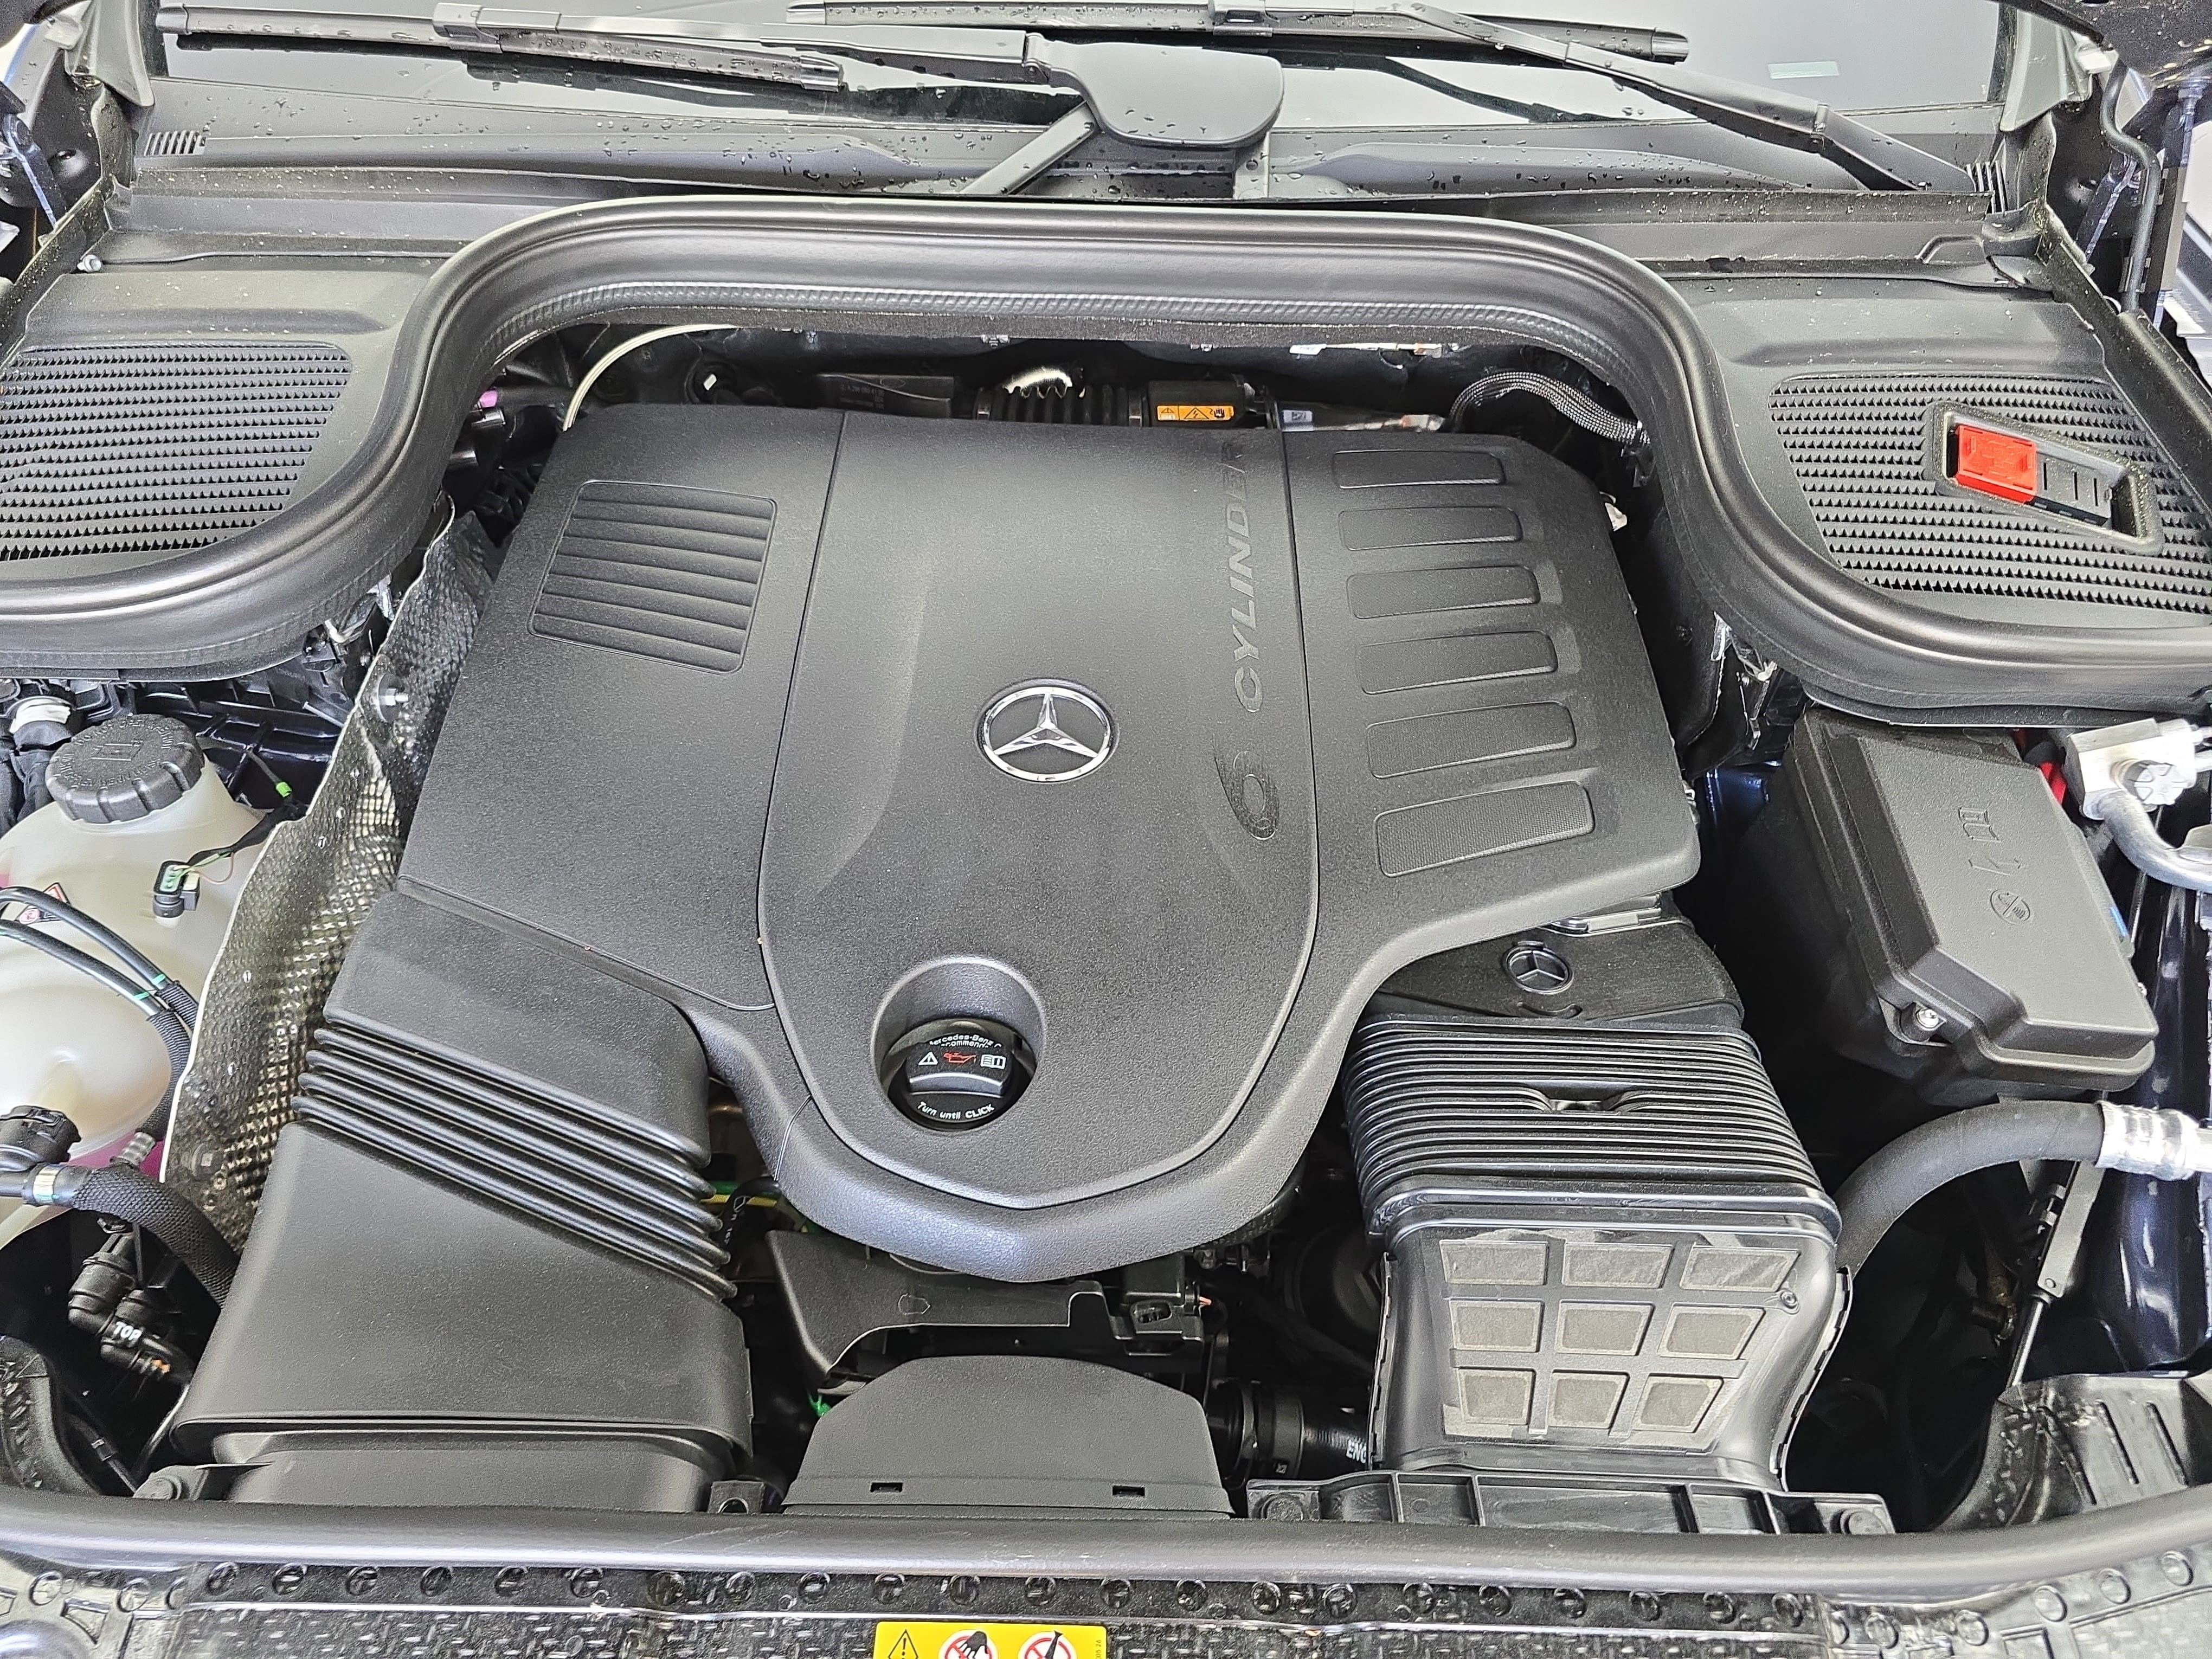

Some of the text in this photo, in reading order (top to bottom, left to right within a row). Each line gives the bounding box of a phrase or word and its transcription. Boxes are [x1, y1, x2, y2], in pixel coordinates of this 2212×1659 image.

[917, 1101, 994, 1120] Turn until CLICK
